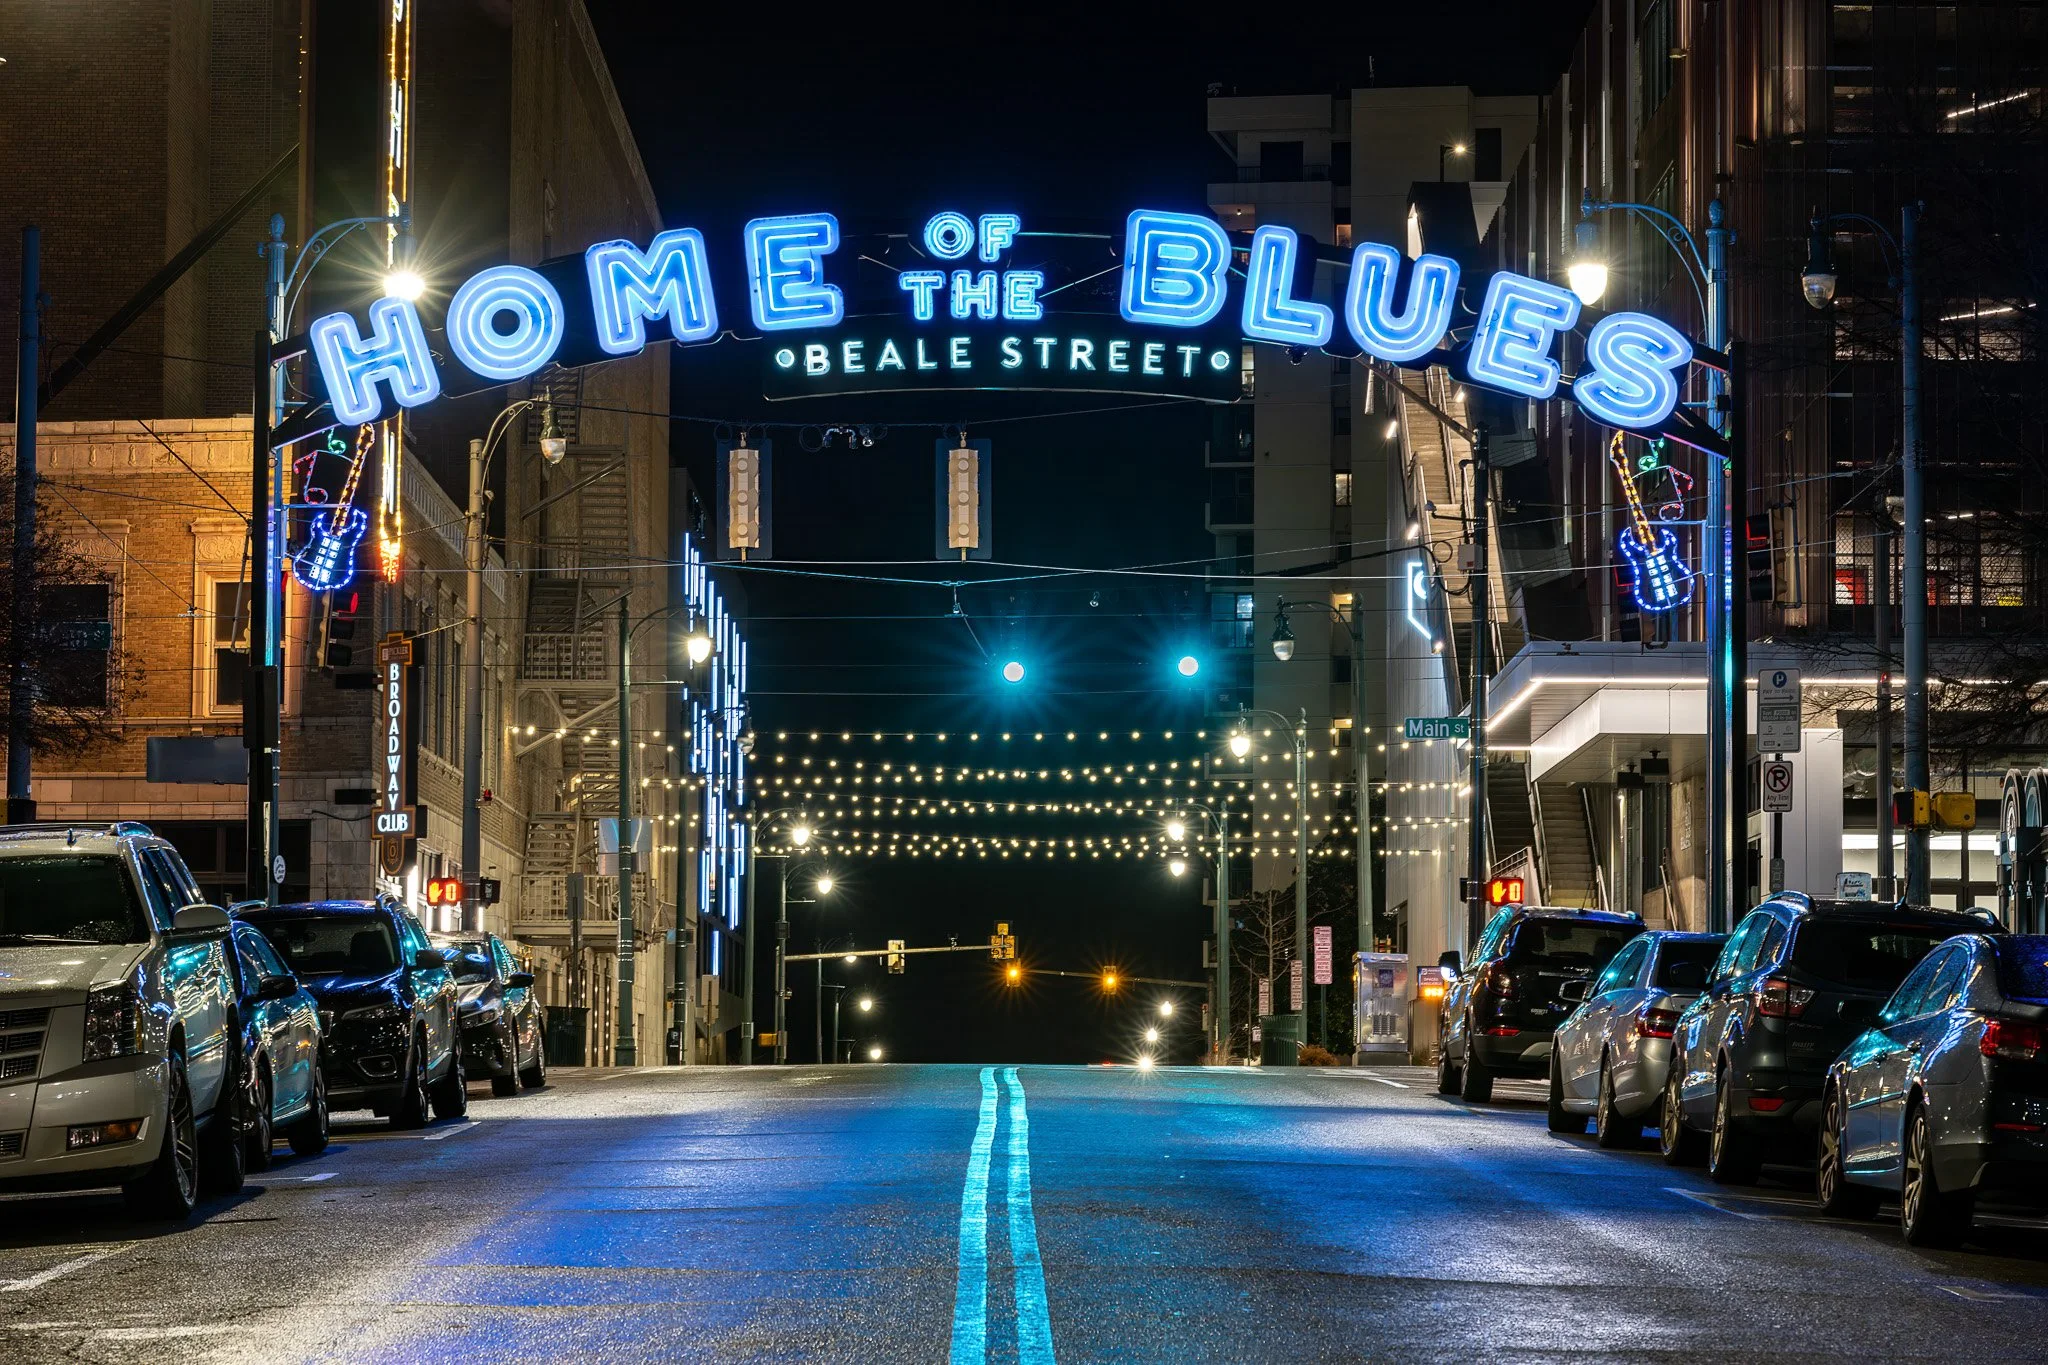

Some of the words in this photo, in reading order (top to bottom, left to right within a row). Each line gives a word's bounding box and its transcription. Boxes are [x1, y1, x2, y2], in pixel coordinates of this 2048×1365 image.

[924, 212, 1021, 262] OF
[310, 213, 845, 426] HOME
[899, 270, 1044, 321] THE
[1120, 209, 1693, 428] BLUES
[805, 337, 972, 377] BEALE
[1002, 336, 1201, 378] STREET
[387, 663, 401, 811] BROADWAY
[1409, 719, 1449, 737] Main
[1454, 723, 1464, 733] St
[377, 813, 408, 832] CLUB
